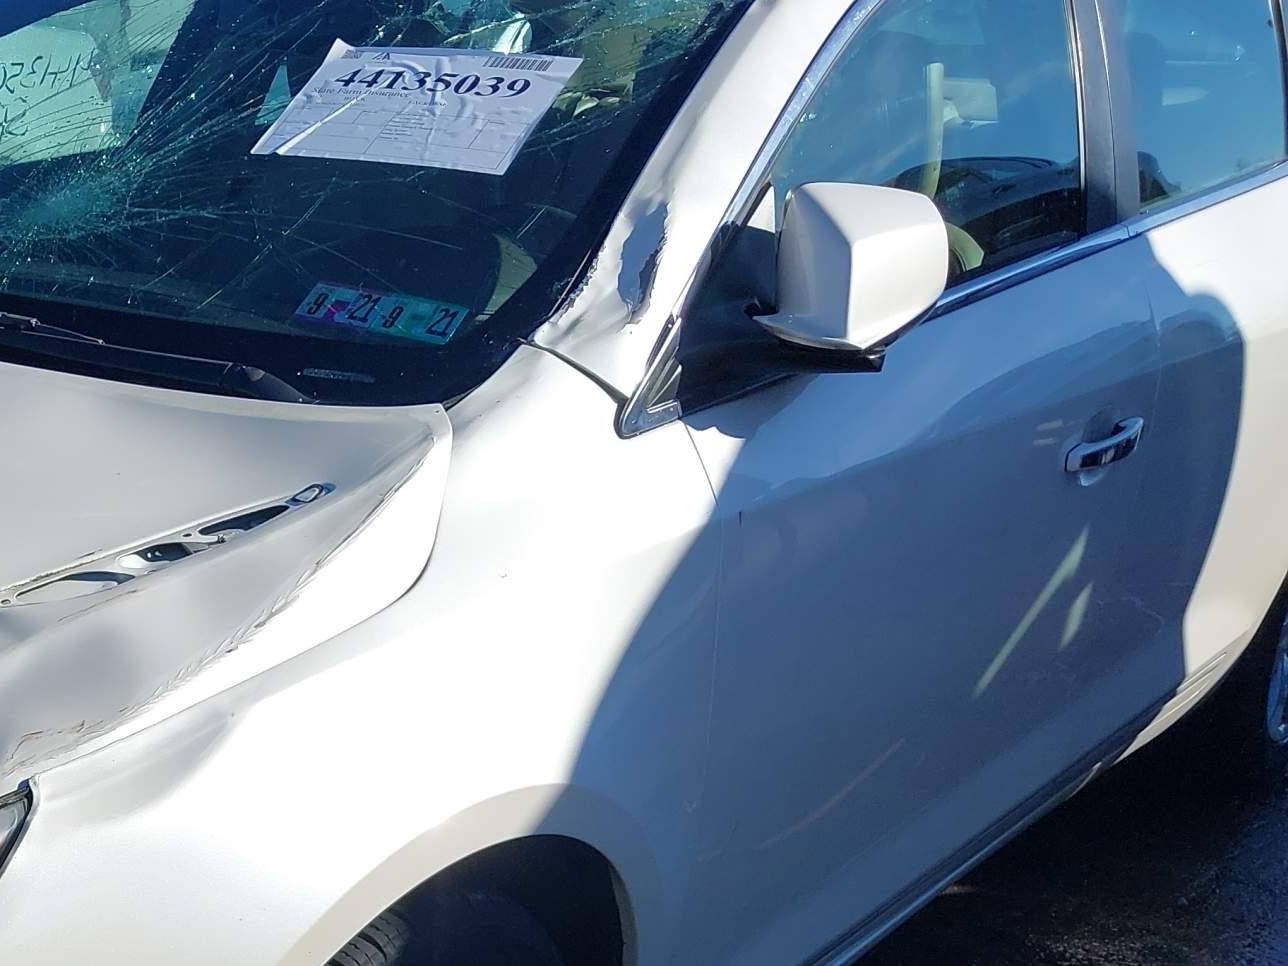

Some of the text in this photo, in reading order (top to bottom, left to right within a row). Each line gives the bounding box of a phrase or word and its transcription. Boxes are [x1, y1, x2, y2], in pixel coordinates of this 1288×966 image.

[311, 86, 335, 95] State
[336, 87, 363, 95] Farm
[335, 67, 532, 98] 44135039
[307, 292, 381, 323] 9 21
[382, 305, 459, 337] 9 21
